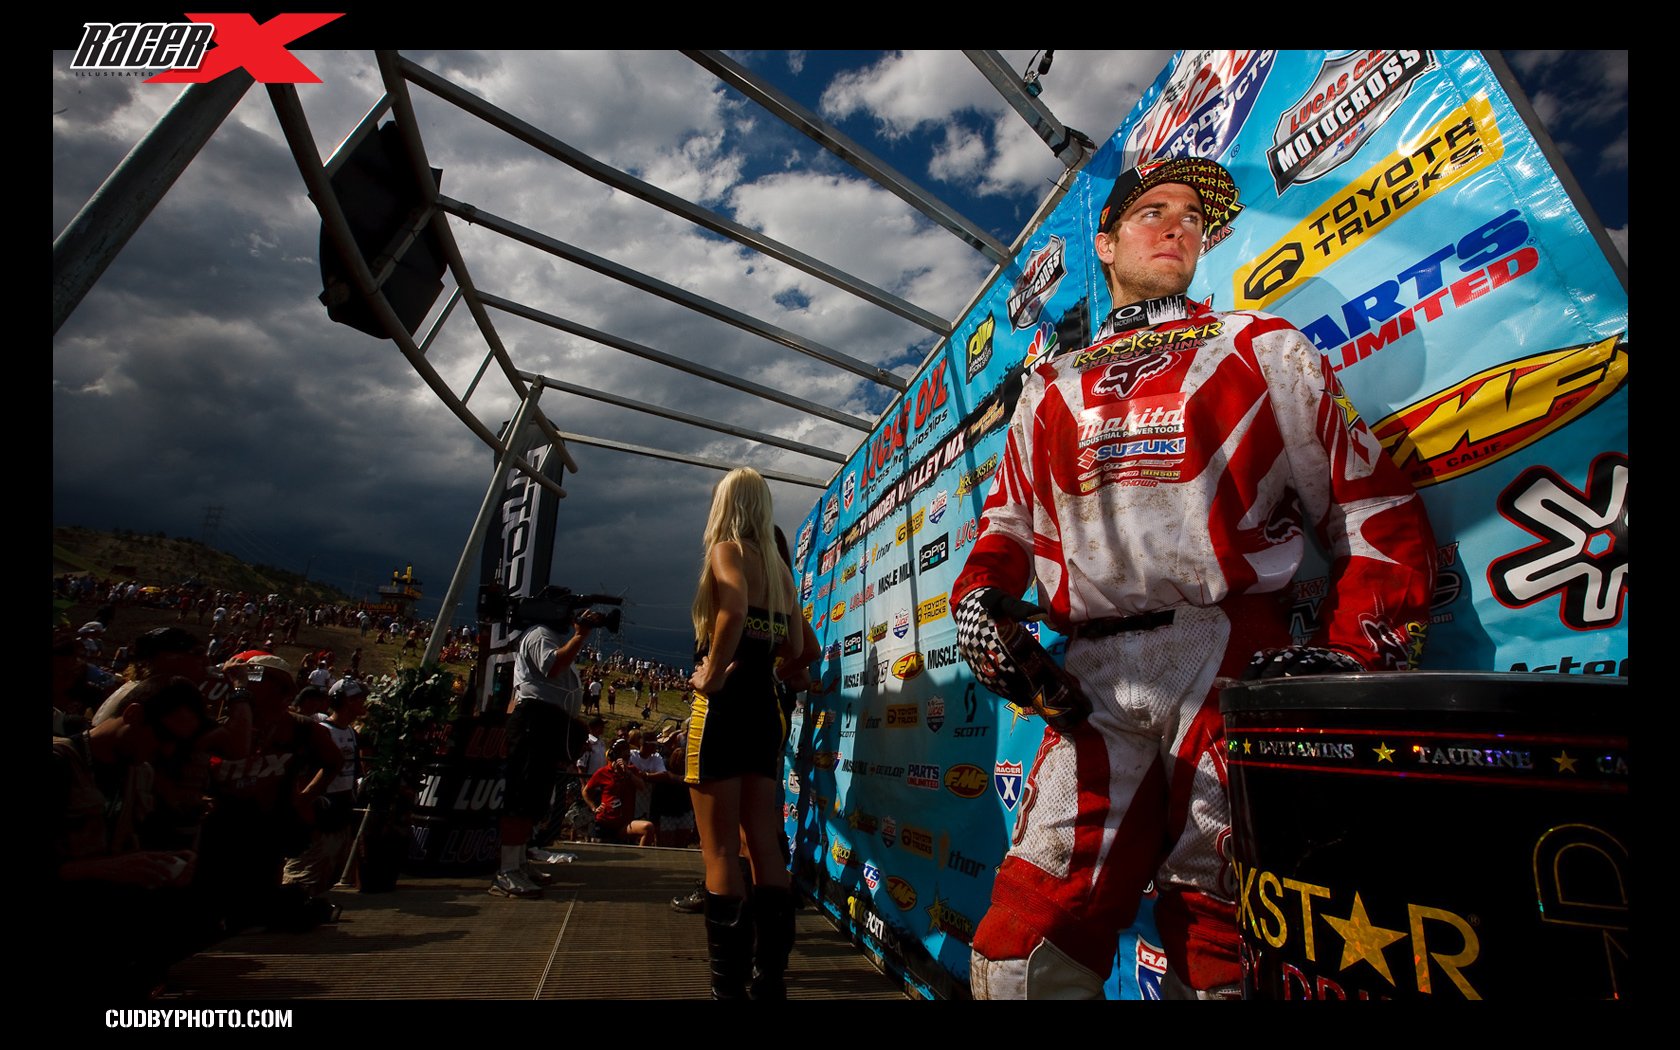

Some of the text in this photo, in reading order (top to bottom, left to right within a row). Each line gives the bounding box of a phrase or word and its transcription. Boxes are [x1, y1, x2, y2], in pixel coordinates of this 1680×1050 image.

[1277, 50, 1421, 173] MOTOCROSS
[1290, 73, 1349, 133] LUCAS
[1309, 116, 1477, 236] TOYOTA
[1314, 138, 1484, 257] TRUCKS
[1300, 209, 1529, 351] ARTS
[1323, 247, 1540, 372] LIMITED
[914, 357, 948, 429] OIL
[1078, 432, 1121, 449] INDUSTRIAL
[1096, 439, 1186, 460] SUZUKI
[898, 448, 943, 501] VALLEY
[943, 429, 965, 466] MX
[924, 597, 946, 610] TOYOTA
[927, 643, 958, 670] MUSCLE
[953, 726, 990, 738] SCOTT
[908, 764, 940, 779] PARTS
[995, 766, 1021, 774] RACER
[1259, 740, 1629, 774] B-VITAMINS TAURINE CA
[945, 768, 988, 790] FMF
[1002, 777, 1017, 801] X
[948, 850, 986, 879] thor
